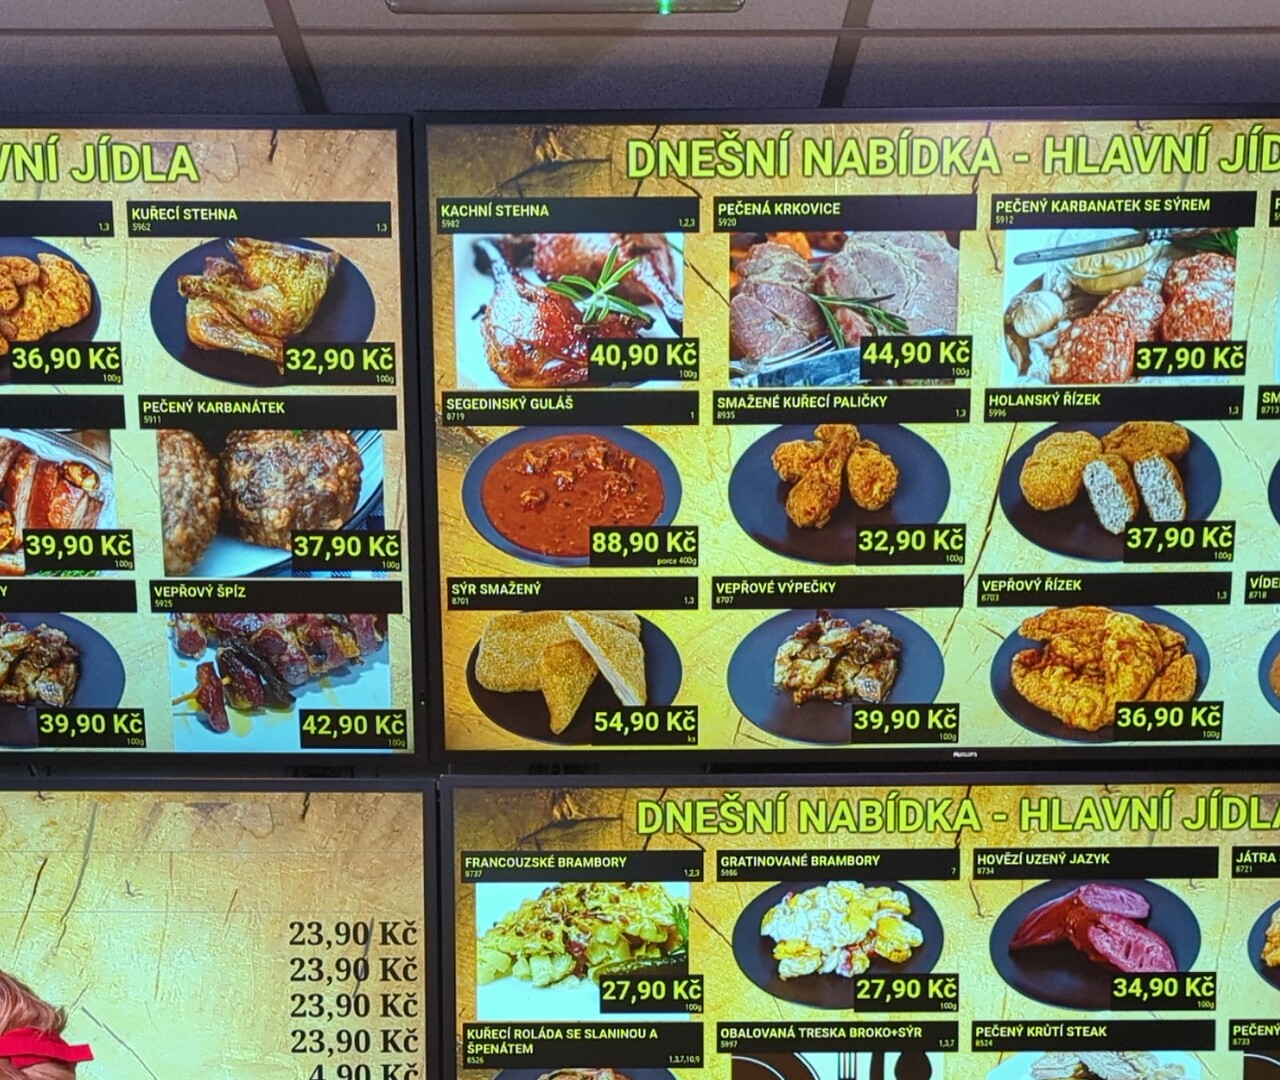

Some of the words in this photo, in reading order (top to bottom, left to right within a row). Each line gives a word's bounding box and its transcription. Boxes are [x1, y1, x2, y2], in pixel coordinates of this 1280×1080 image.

[71, 134, 199, 182] JÍDLA
[627, 130, 790, 179] DNEŠNÍ
[802, 129, 1001, 177] NABÍDKA
[1044, 126, 1211, 175] HLAVNÍ
[130, 204, 181, 222] KUŘECÍ
[182, 207, 239, 222] STEHNA
[440, 200, 494, 218] KACHNÍ
[494, 203, 551, 218] STEHNA
[717, 198, 773, 217] PEČENÁ
[773, 201, 842, 217] KRKOVICE
[589, 342, 660, 371] 40,90
[665, 341, 698, 367] Kč
[141, 397, 195, 414] PEČENÝ
[196, 397, 286, 415] KARBANÁTEK
[445, 394, 528, 411] SEGEDINSKÝ
[529, 394, 575, 411] GULÁŠ
[24, 533, 95, 561] 39,90
[99, 533, 133, 557] Kč
[591, 530, 660, 557] 88,90
[665, 529, 698, 554] Kč
[450, 580, 478, 596] SÝR
[478, 579, 543, 596] SMAŽENÝ
[301, 713, 369, 739] 42,90
[374, 712, 406, 736] Kč
[1115, 705, 1185, 732] 36,90
[1189, 704, 1222, 728] Kč
[637, 792, 789, 834] DNEŠNÍ
[799, 792, 981, 833] NABÍDKA
[1020, 789, 1174, 832] HLAVNÍ
[464, 853, 556, 870] FRANCOUZSKÉ
[556, 855, 628, 869] BRAMBORY
[976, 850, 1025, 867] HOVĚZÍ
[1024, 850, 1068, 866] UZENÝ
[1068, 852, 1112, 866] JAZYK
[1234, 848, 1278, 864] JÁTRA
[289, 922, 370, 949] 23,90
[379, 921, 417, 946] Kč
[601, 979, 667, 1004] 27,90
[672, 978, 703, 1001] Kč
[719, 1023, 797, 1040] OBALOVANÁ
[797, 1026, 848, 1039] TRESKA
[848, 1023, 924, 1039] BROKO+SÝR
